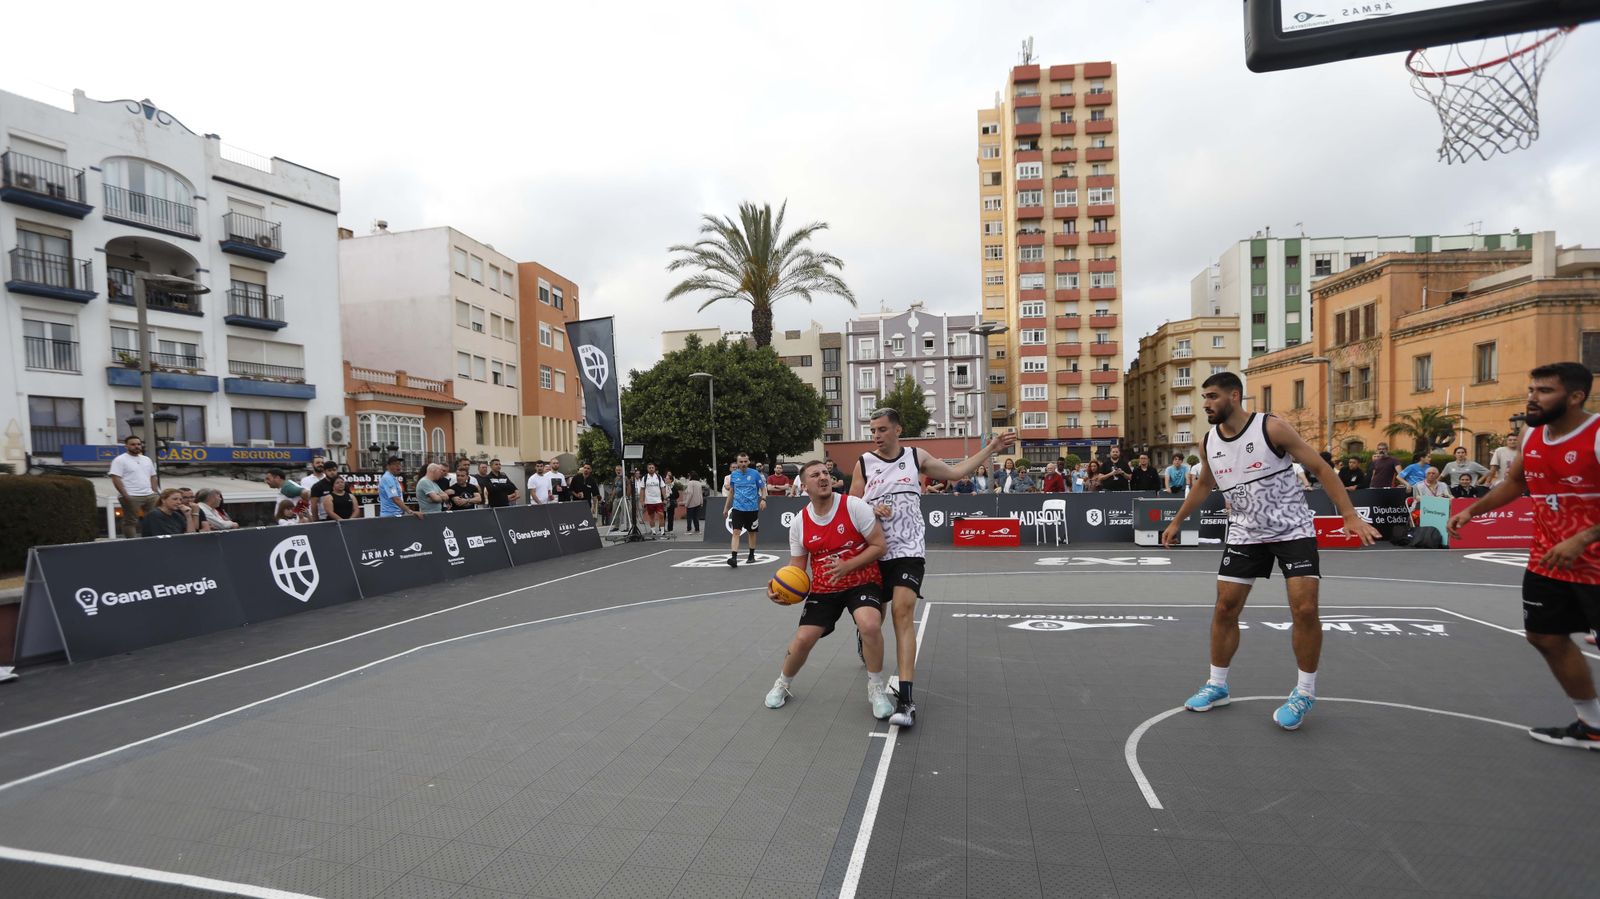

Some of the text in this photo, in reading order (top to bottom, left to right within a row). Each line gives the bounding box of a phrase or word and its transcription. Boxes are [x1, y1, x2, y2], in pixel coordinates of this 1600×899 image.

[232, 450, 291, 460] SEGUROS
[340, 474, 371, 482] Kebab
[1235, 483, 1247, 498] 3
[1545, 493, 1559, 511] 4
[1372, 505, 1408, 515] Diputació
[1009, 510, 1061, 526] MADISON
[1375, 516, 1385, 524] de
[516, 531, 532, 540] Gana
[292, 538, 306, 547] FEB
[361, 548, 395, 561] ARMAS
[101, 576, 218, 606] Gana Energía
